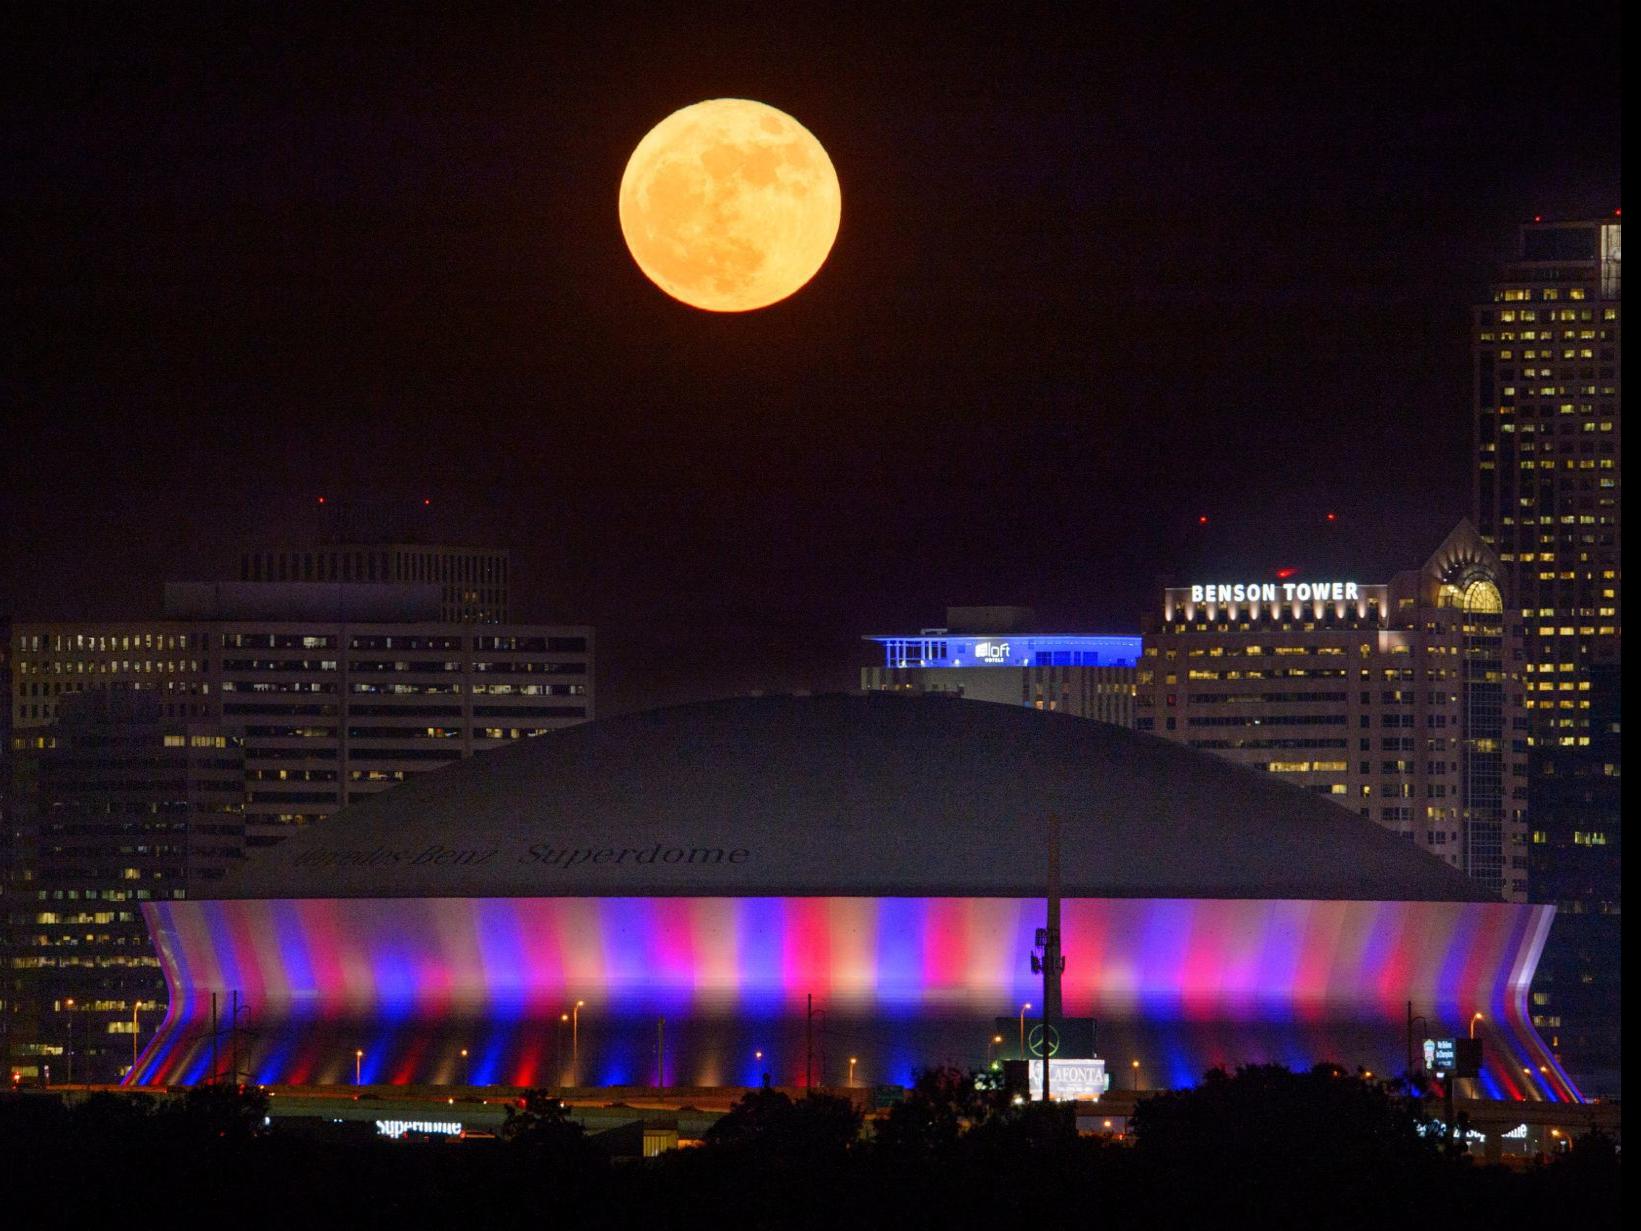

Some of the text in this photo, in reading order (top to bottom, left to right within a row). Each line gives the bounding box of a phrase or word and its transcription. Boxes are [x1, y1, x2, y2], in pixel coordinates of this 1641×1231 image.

[1191, 581, 1359, 603] BENSON TOWER
[517, 842, 751, 870] Superdome
